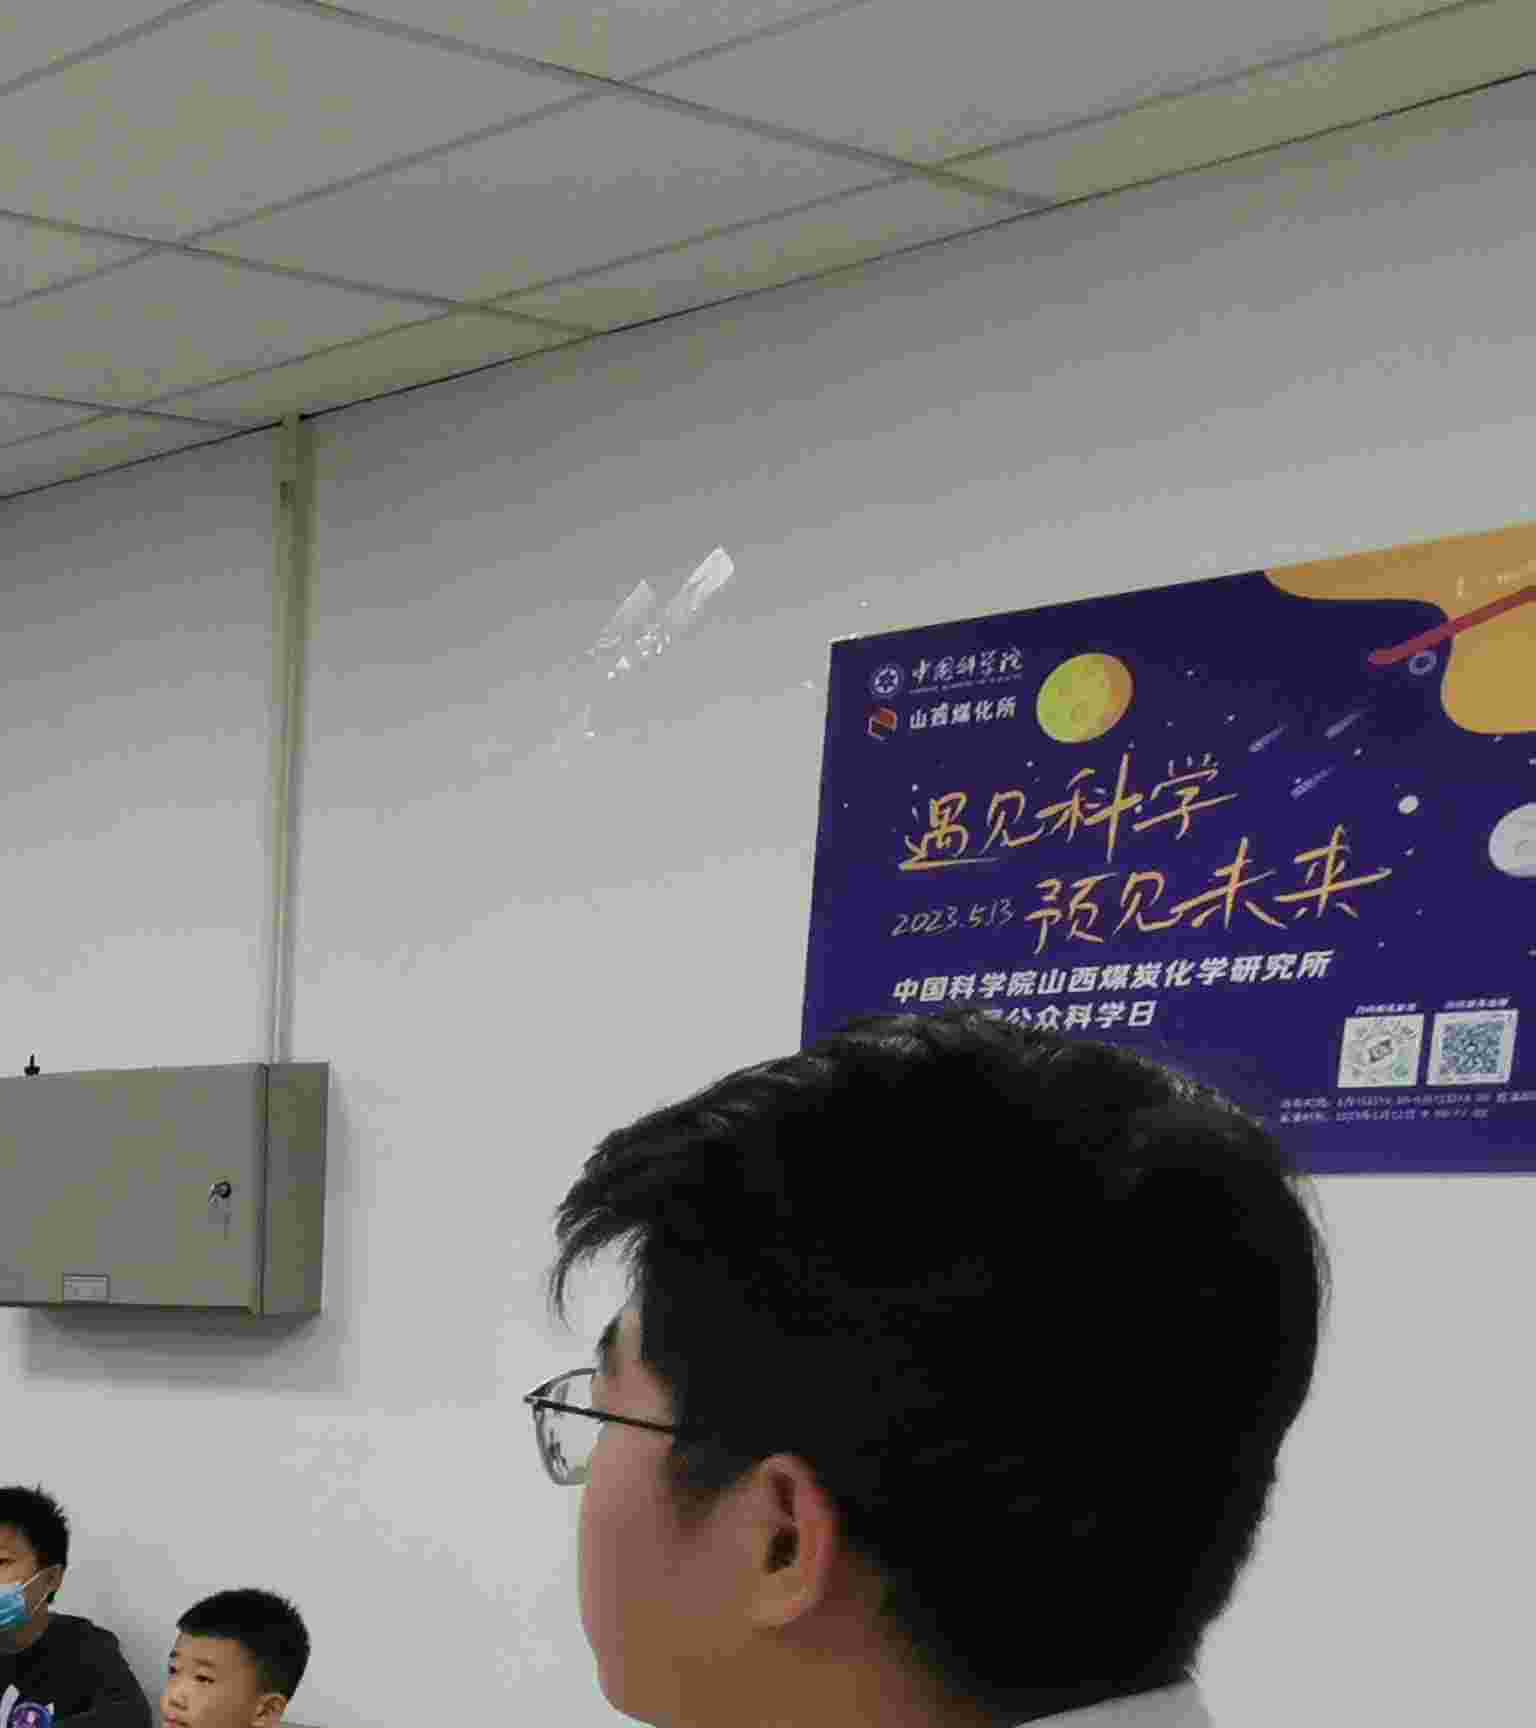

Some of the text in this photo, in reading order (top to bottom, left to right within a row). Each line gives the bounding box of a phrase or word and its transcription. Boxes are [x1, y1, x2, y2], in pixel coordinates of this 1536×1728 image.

[910, 696, 1016, 729] 山西煤化所
[898, 752, 1238, 871] 遇见科学
[1024, 823, 1393, 954] 预见未来
[892, 949, 1334, 1004] 中国科学院山西煤炭化学研究所
